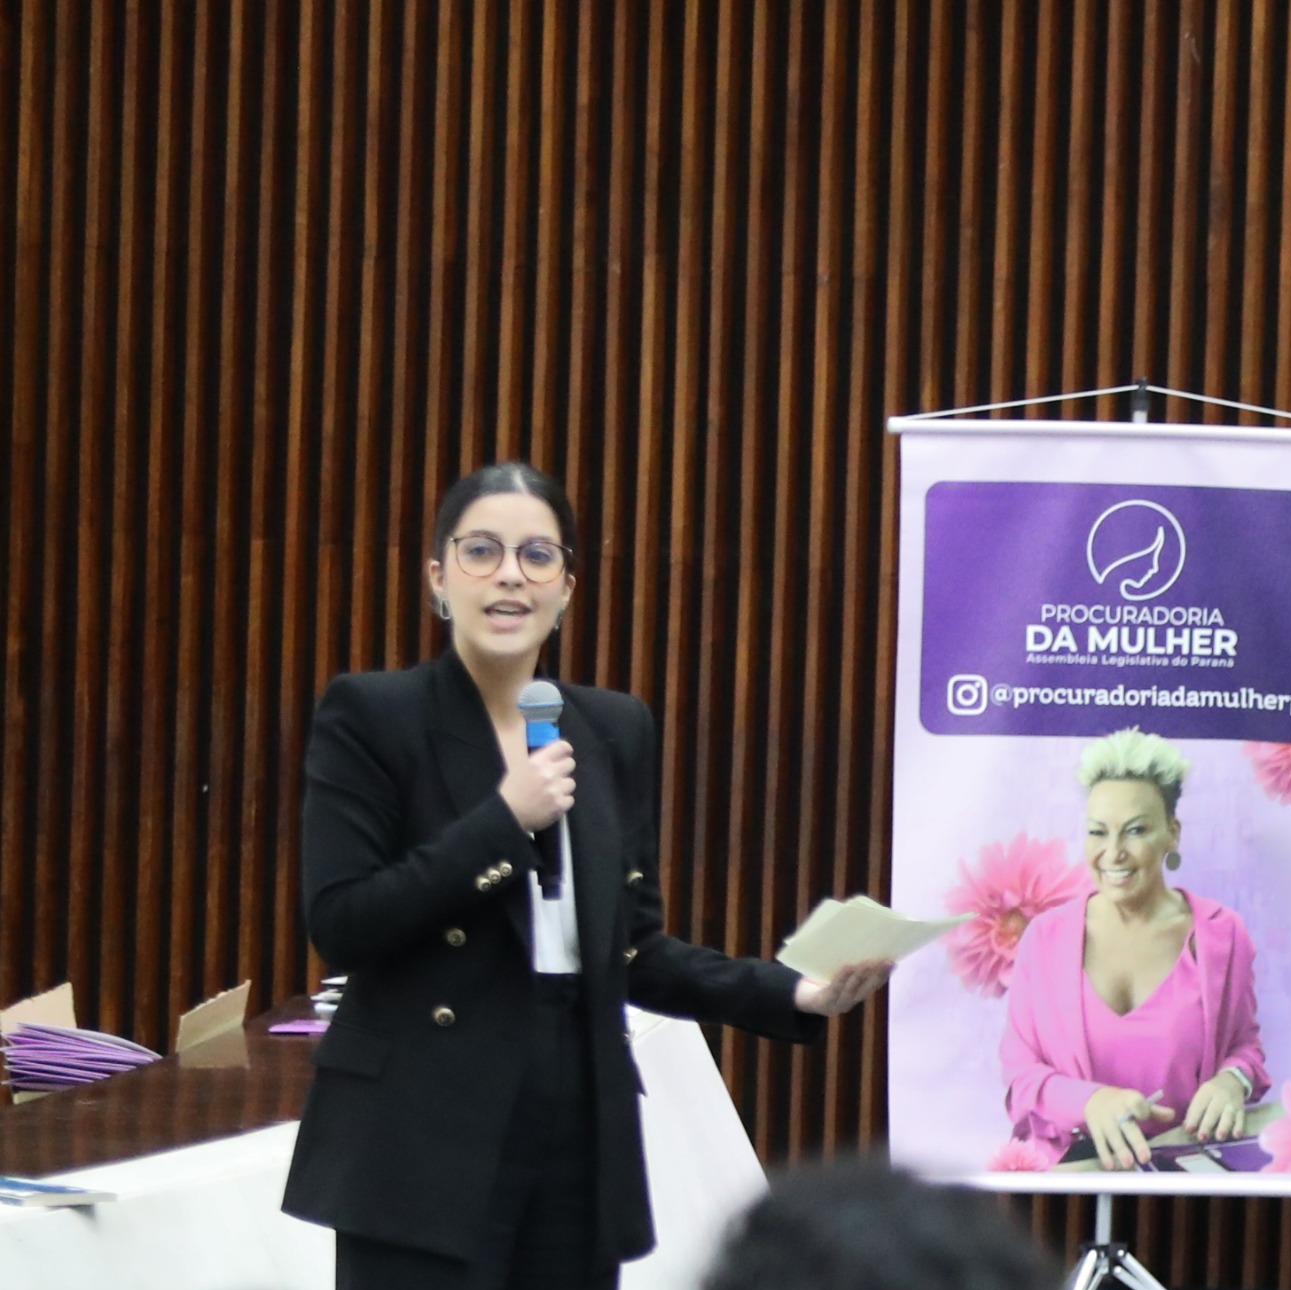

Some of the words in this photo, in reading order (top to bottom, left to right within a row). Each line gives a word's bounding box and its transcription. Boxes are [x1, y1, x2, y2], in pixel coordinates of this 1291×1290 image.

[1041, 603, 1225, 627] PROCURADORIA
[1026, 623, 1078, 653] DA
[1087, 625, 1238, 657] MULHER
[1026, 652, 1098, 666] Assembleia
[1102, 654, 1169, 668] Legislativa
[1171, 656, 1188, 667] do
[1191, 656, 1235, 669] Paraná
